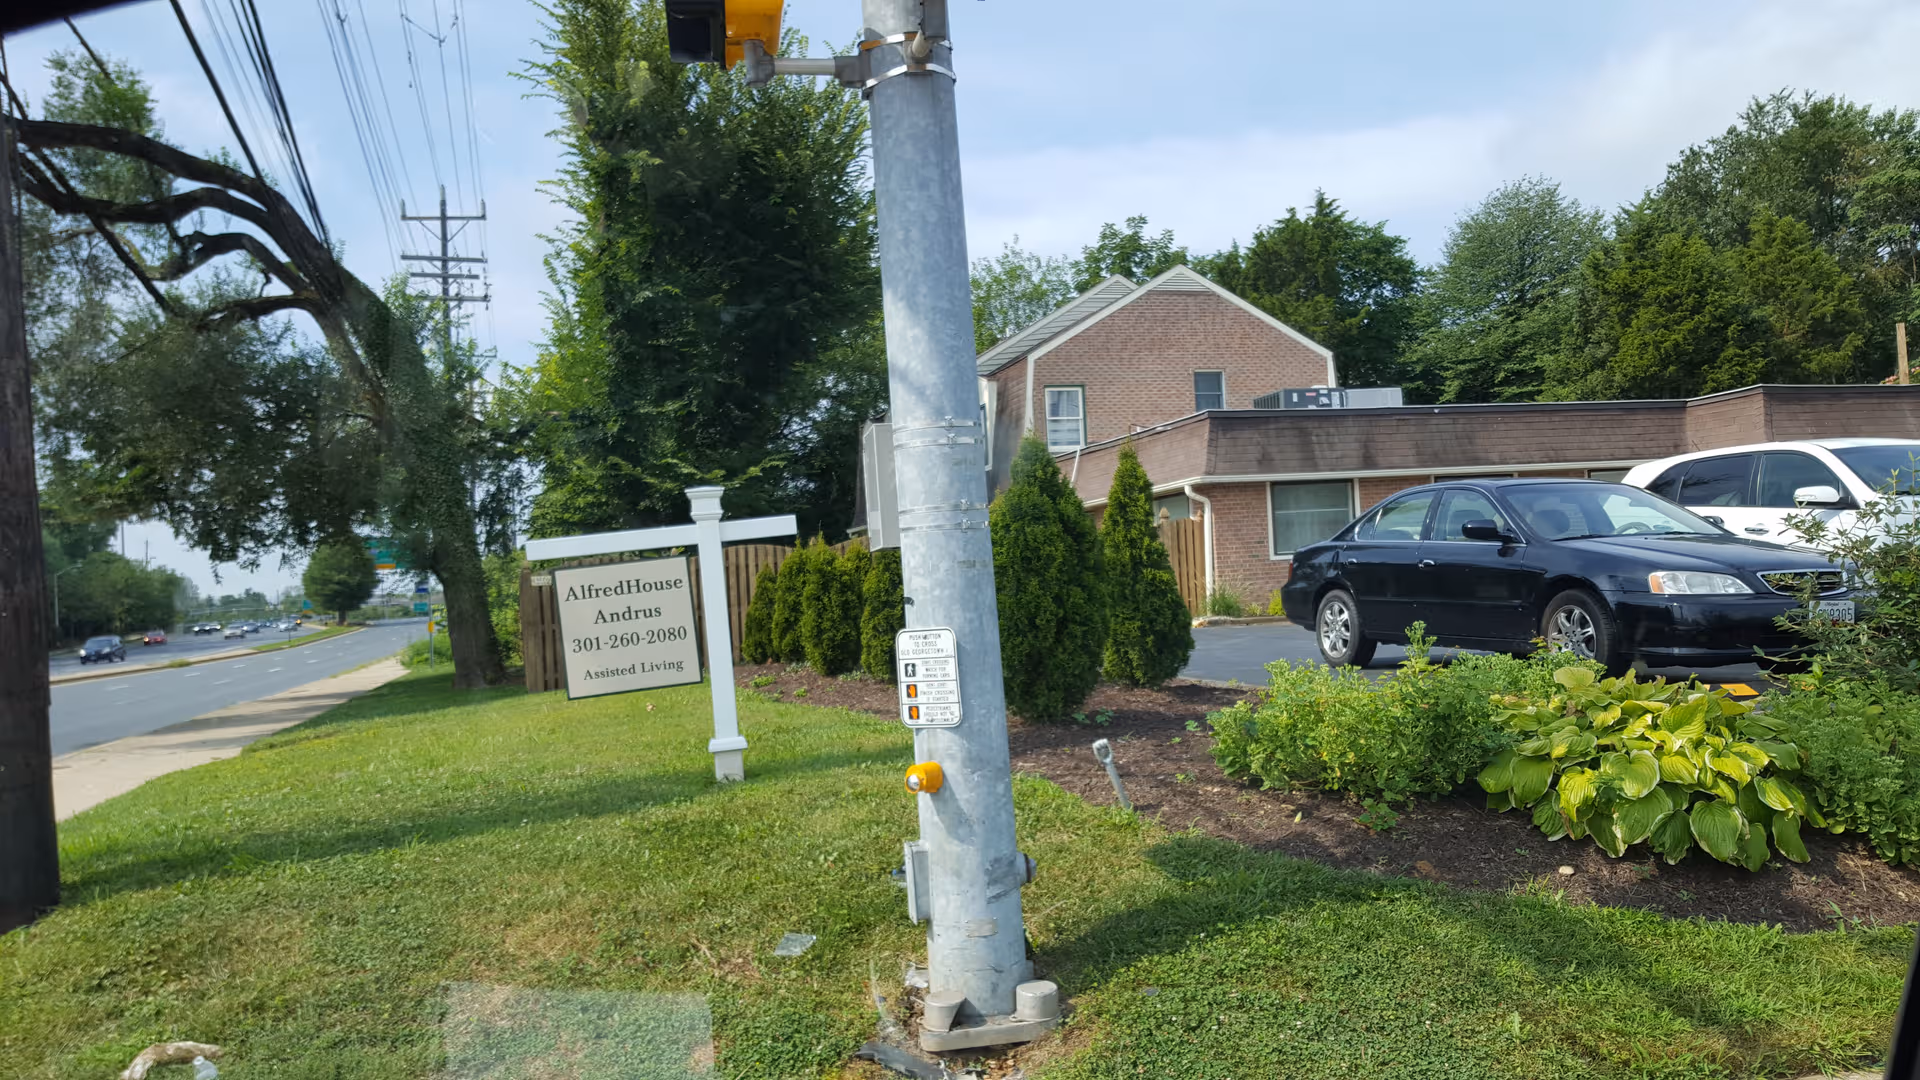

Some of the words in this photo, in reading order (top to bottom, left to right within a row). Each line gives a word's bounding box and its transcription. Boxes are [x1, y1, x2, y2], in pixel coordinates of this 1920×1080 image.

[565, 578, 683, 602] AlfredHouse
[594, 606, 662, 625] Andrus
[572, 626, 687, 654] 301-260-2080
[912, 648, 944, 656] GEORGETOWN
[584, 664, 636, 681] Assisted
[640, 660, 684, 672] Living
